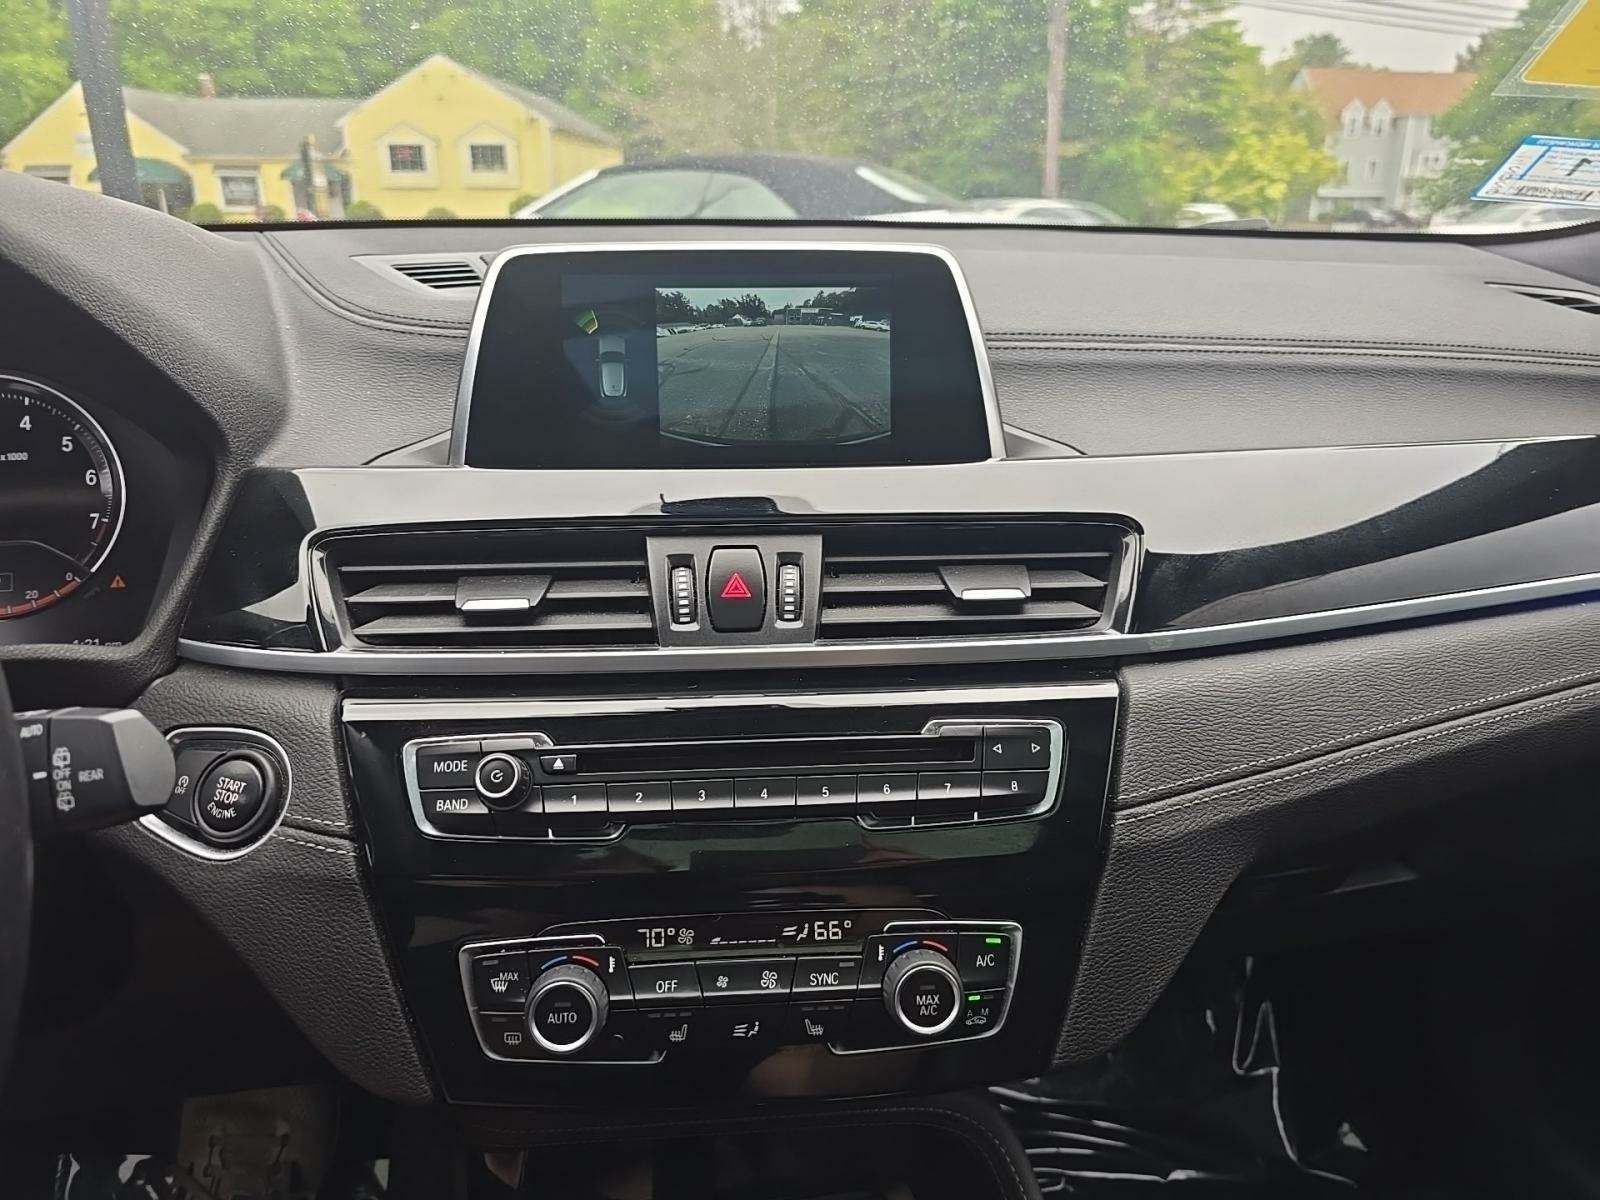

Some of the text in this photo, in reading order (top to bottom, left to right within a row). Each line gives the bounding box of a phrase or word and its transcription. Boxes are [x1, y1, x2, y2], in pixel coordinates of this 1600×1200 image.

[19, 415, 32, 431] 4
[61, 436, 73, 452] 5
[85, 469, 97, 486] 6
[89, 513, 100, 529] 7
[65, 572, 73, 581] 0
[25, 590, 39, 599] 20
[20, 724, 43, 738] AUTO
[433, 760, 468, 773] MODE
[78, 768, 104, 782] REAR
[174, 786, 188, 795] OFF
[216, 776, 248, 794] START
[213, 788, 239, 804] STOP
[571, 780, 1019, 806] 1 2 3 4 5 6 7 8
[207, 802, 237, 820] ENGINE
[435, 798, 469, 811] BAND
[976, 953, 995, 968] A/C
[499, 971, 519, 982] MAX
[809, 972, 839, 986] SYNC
[655, 980, 678, 993] OFF
[916, 994, 940, 1006] MAX
[919, 1004, 938, 1017] A/C
[547, 1012, 577, 1025] AUTO
